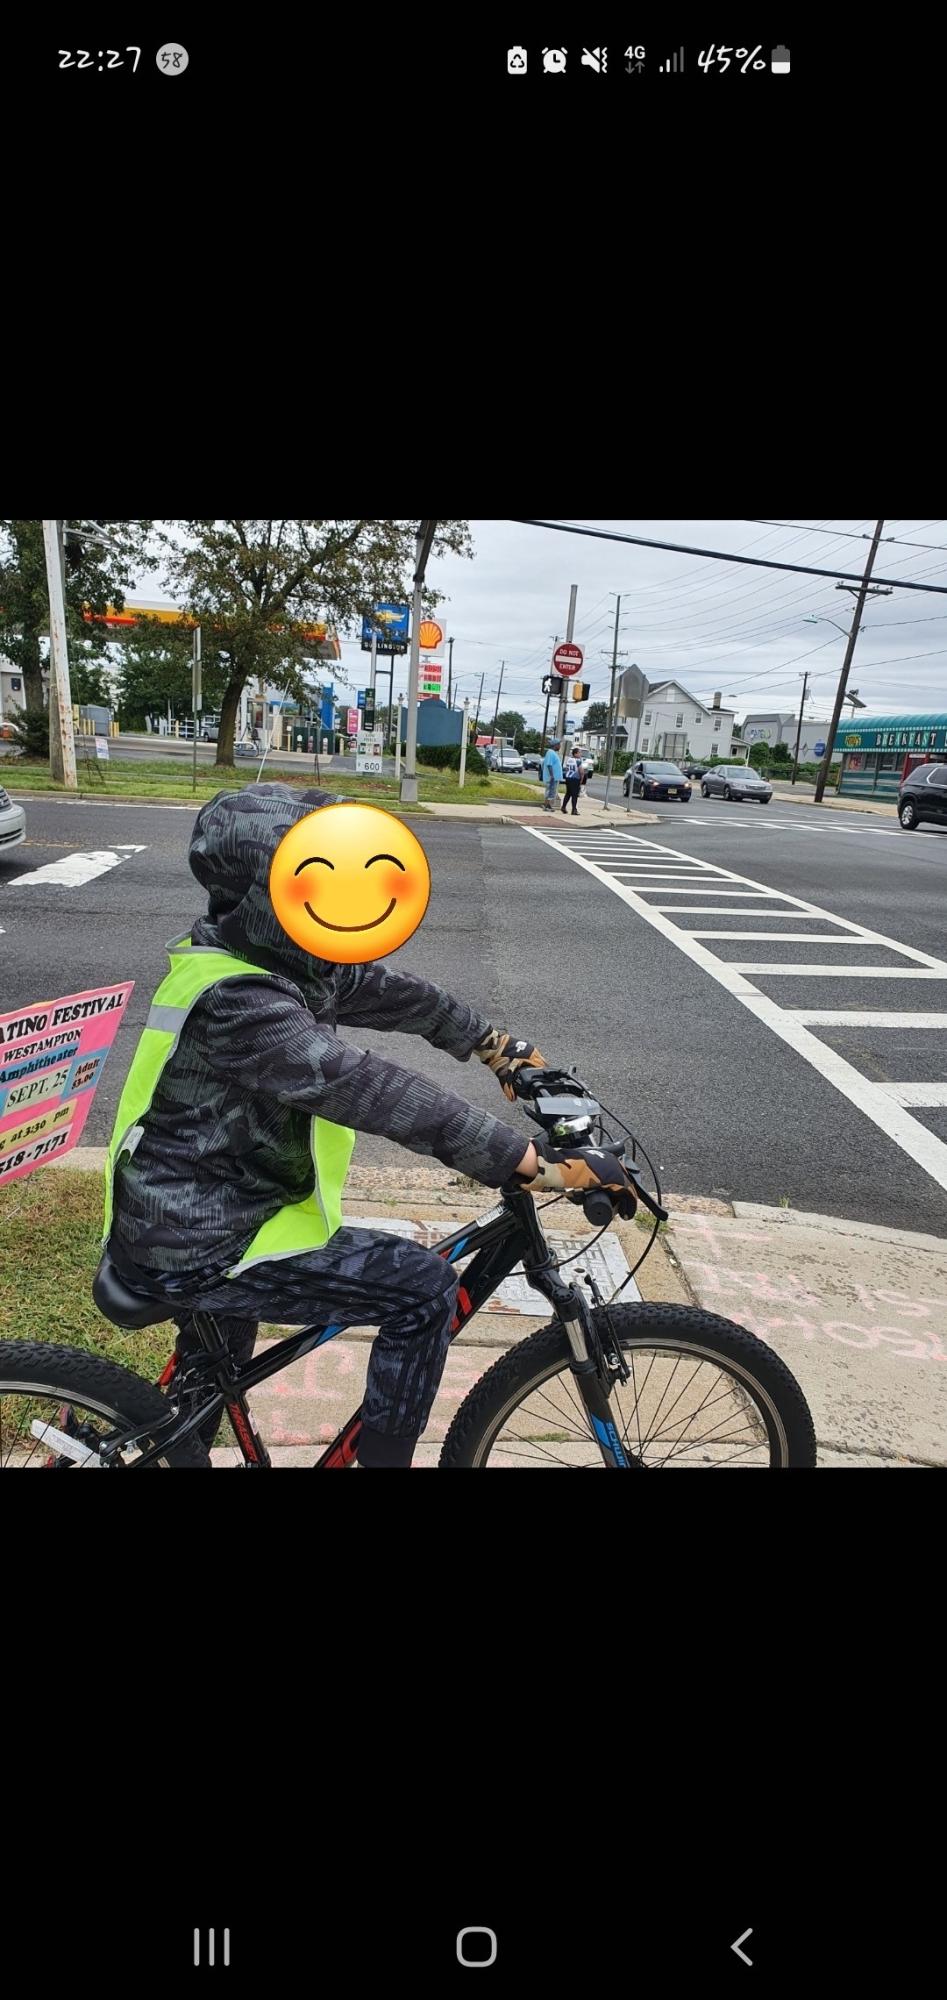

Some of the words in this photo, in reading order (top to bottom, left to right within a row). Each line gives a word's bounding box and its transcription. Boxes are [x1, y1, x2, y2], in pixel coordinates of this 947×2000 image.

[876, 732, 936, 747] BREAKFAST
[51, 993, 124, 1026] FESTIVAL
[3, 1028, 83, 1063] WESTAMPTON
[0, 1047, 79, 1083] Amphitheater
[75, 1058, 100, 1076] Adult
[6, 1077, 49, 1108] SEPT.
[52, 1068, 69, 1087] 25
[53, 1106, 70, 1123] pm
